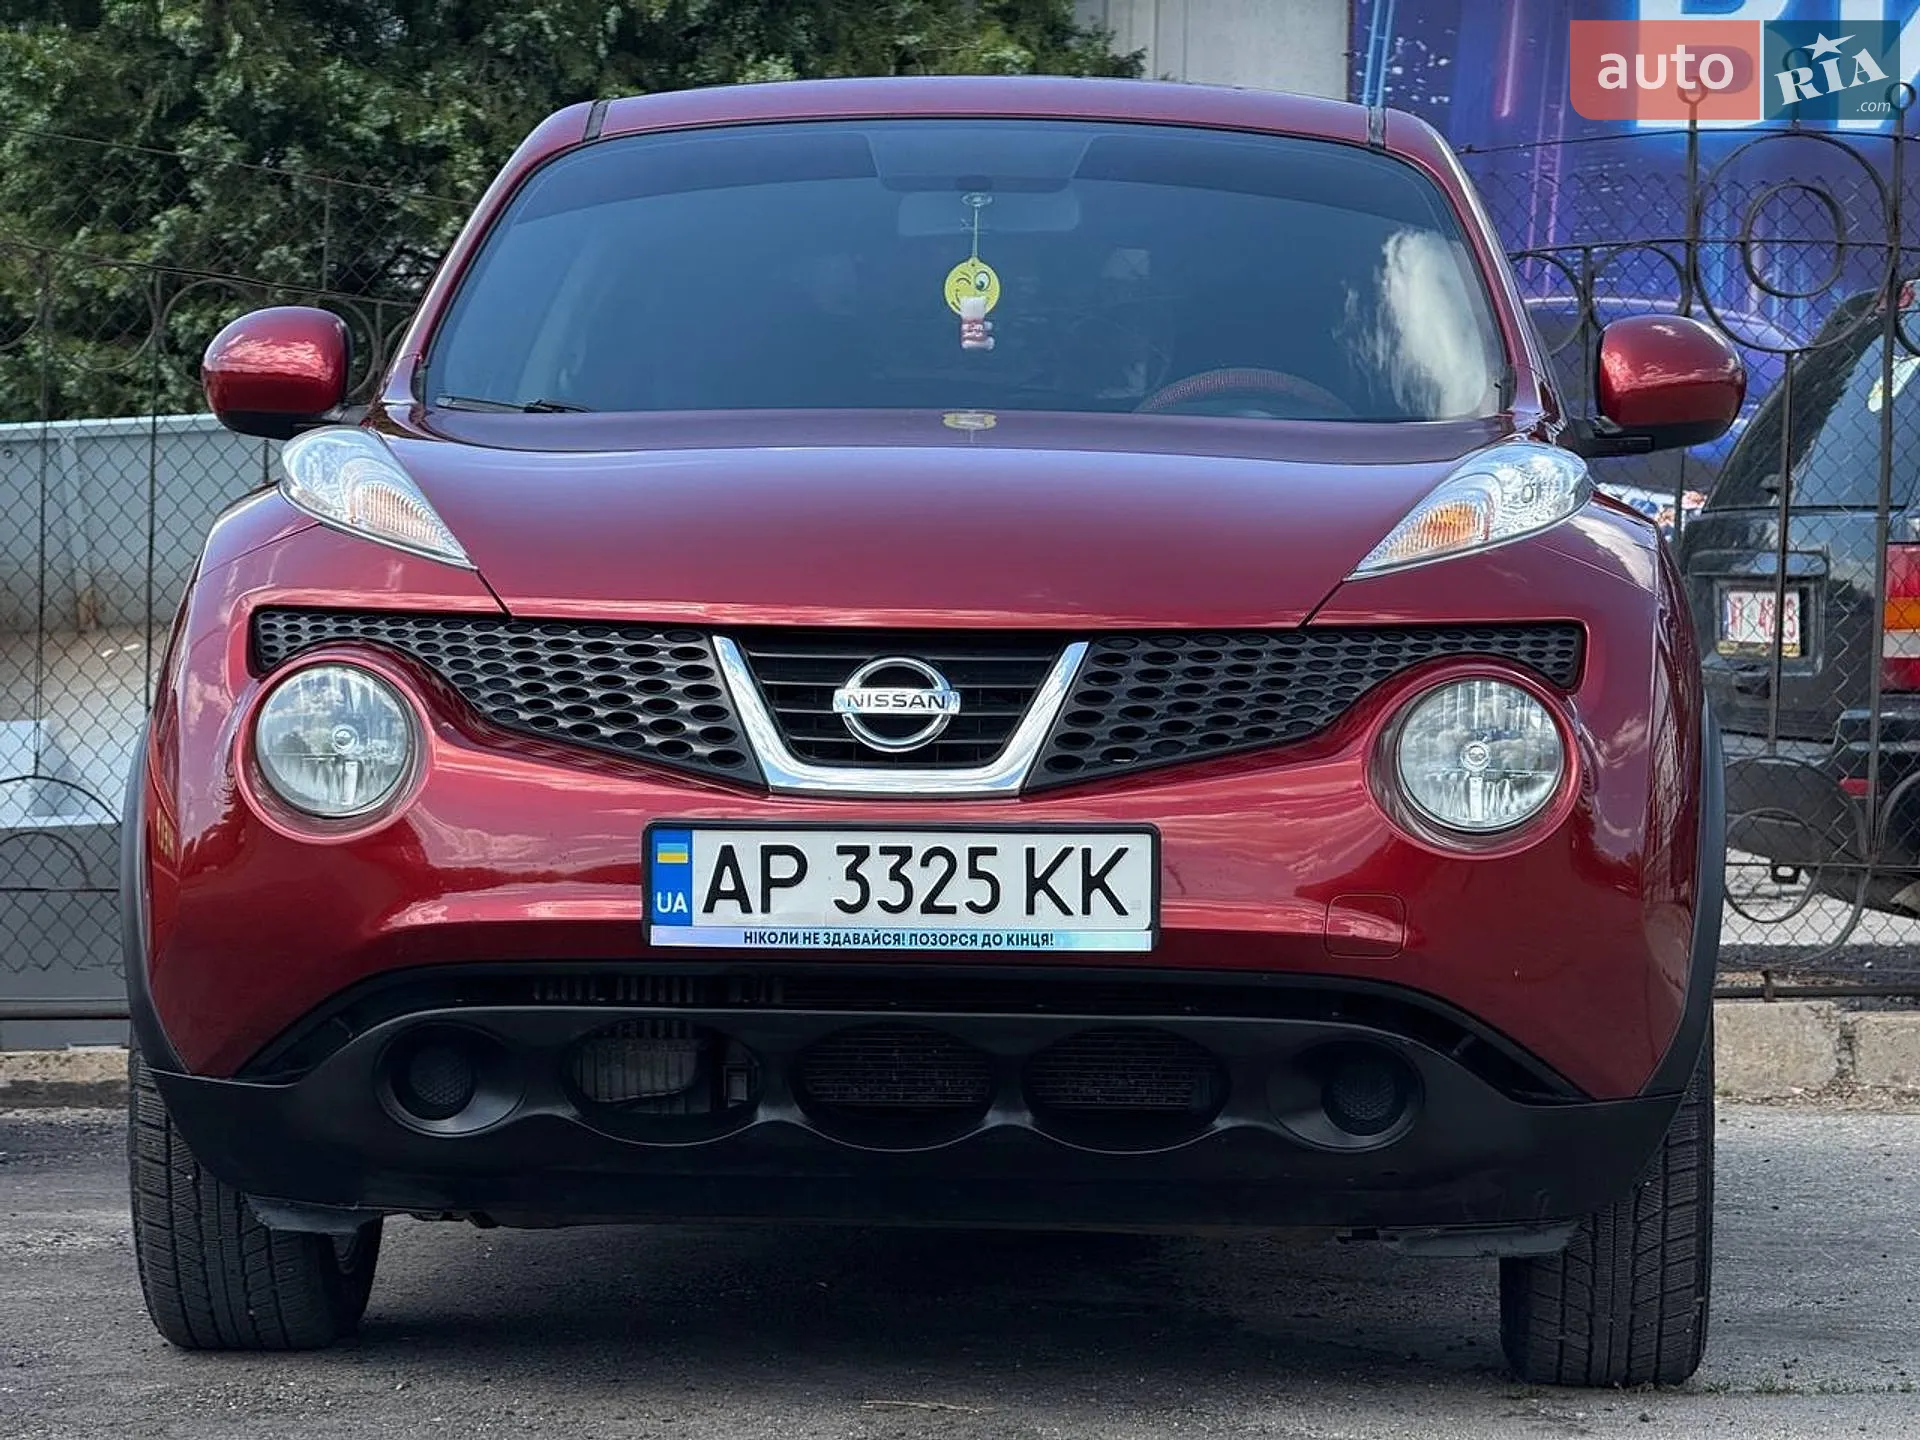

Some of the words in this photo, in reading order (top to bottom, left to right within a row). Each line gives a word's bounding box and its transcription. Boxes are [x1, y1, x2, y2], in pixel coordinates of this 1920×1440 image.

[846, 693, 946, 709] NISSAN
[702, 844, 808, 914] AP
[833, 845, 1001, 915] 3325
[1025, 846, 1130, 916] KK
[656, 892, 688, 913] UA
[743, 931, 799, 945] НІКОЛИ
[802, 931, 820, 945] НЕ
[823, 929, 905, 947] ЗДАВАЙСЯ!
[909, 932, 978, 946] ПОЗОРСЯ
[981, 932, 1003, 948] ДО
[1006, 932, 1054, 948] КІНЦЯ!
